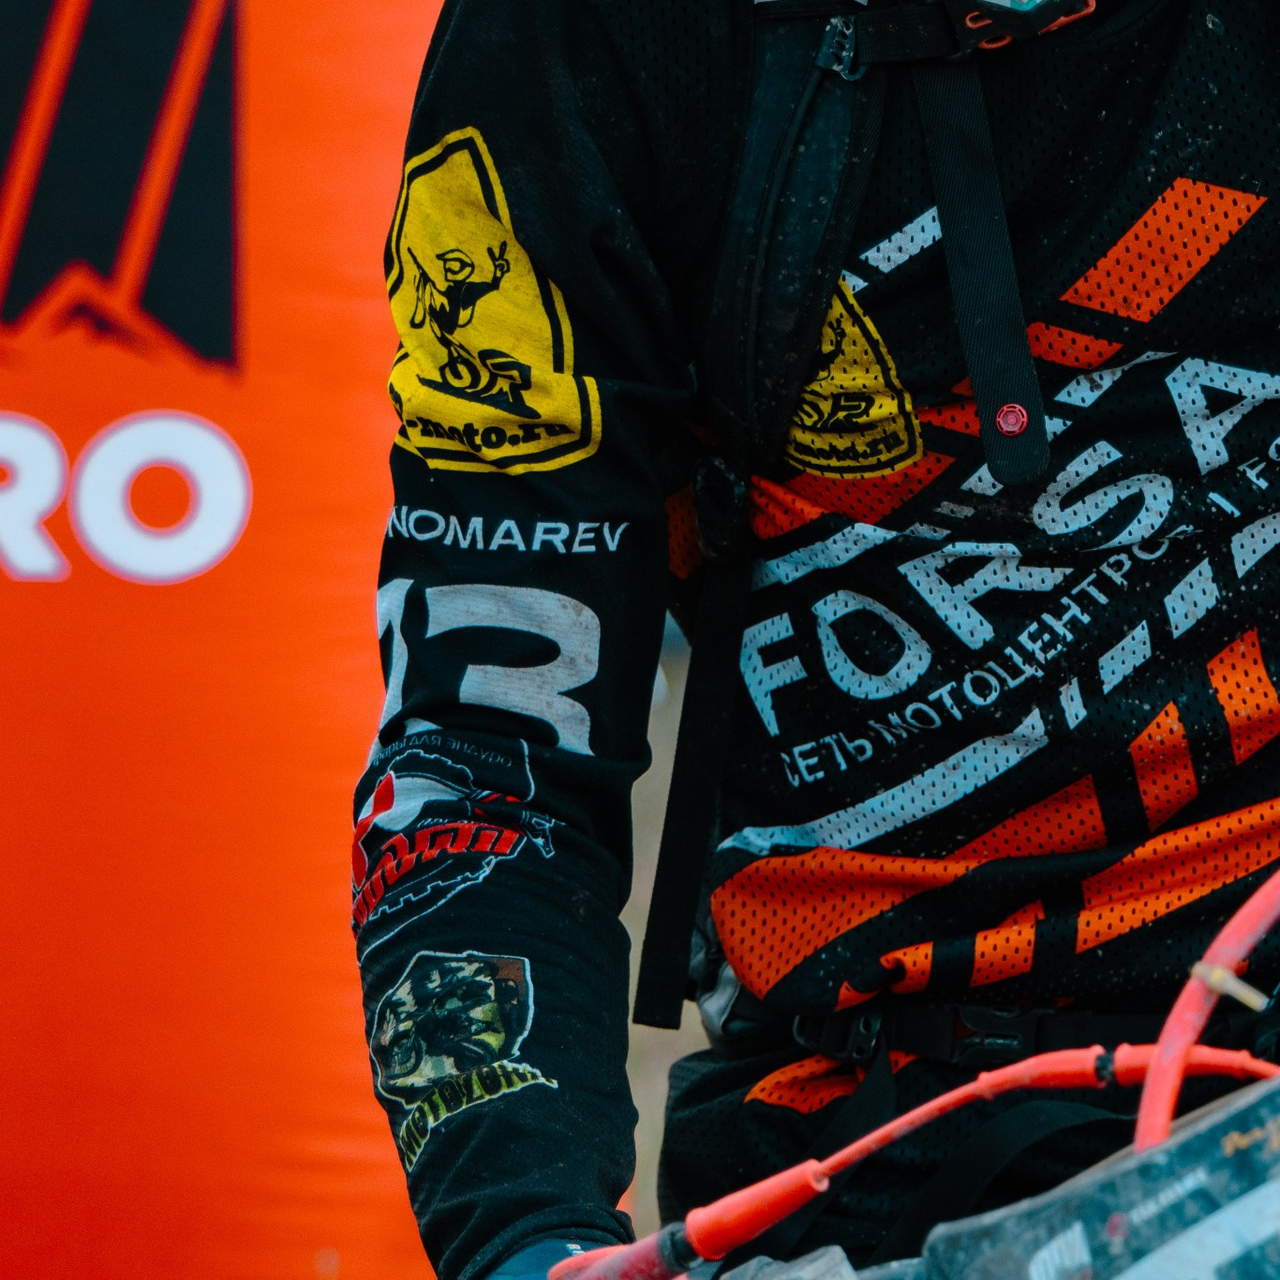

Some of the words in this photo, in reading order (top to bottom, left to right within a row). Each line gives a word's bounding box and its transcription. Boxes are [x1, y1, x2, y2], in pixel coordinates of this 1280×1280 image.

[404, 416, 575, 453] -moto.ru
[0, 408, 253, 585] RO
[386, 505, 631, 554] NOMAREV
[780, 730, 873, 789] СЕТЬ
[868, 523, 1202, 748] МОТОЦЕНТРО
